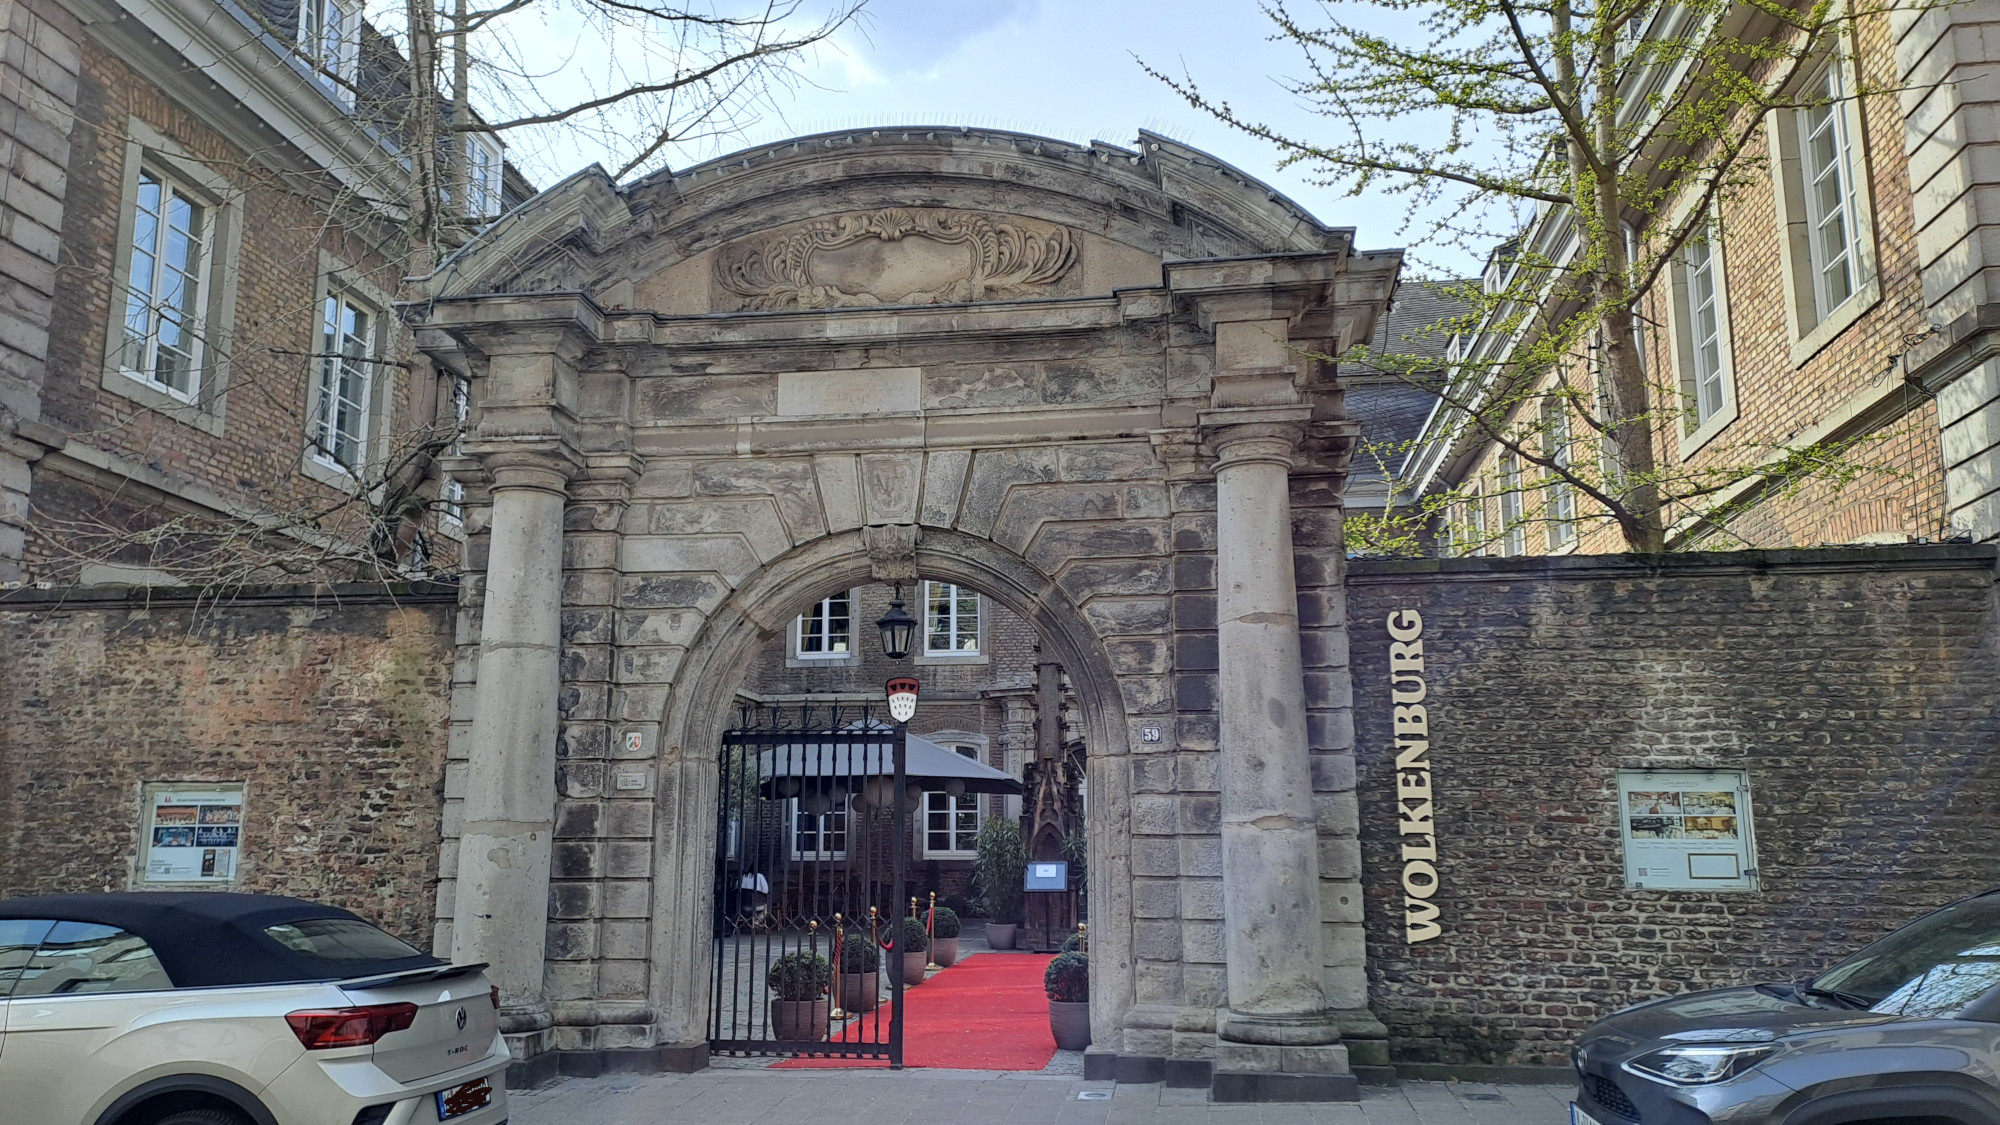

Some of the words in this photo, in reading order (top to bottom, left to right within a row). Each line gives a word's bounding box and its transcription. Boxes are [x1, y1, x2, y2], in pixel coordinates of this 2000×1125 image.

[1144, 728, 1160, 742] 59
[1387, 609, 1442, 944] WOLKENBURG
[447, 1045, 469, 1056] T-ROC
